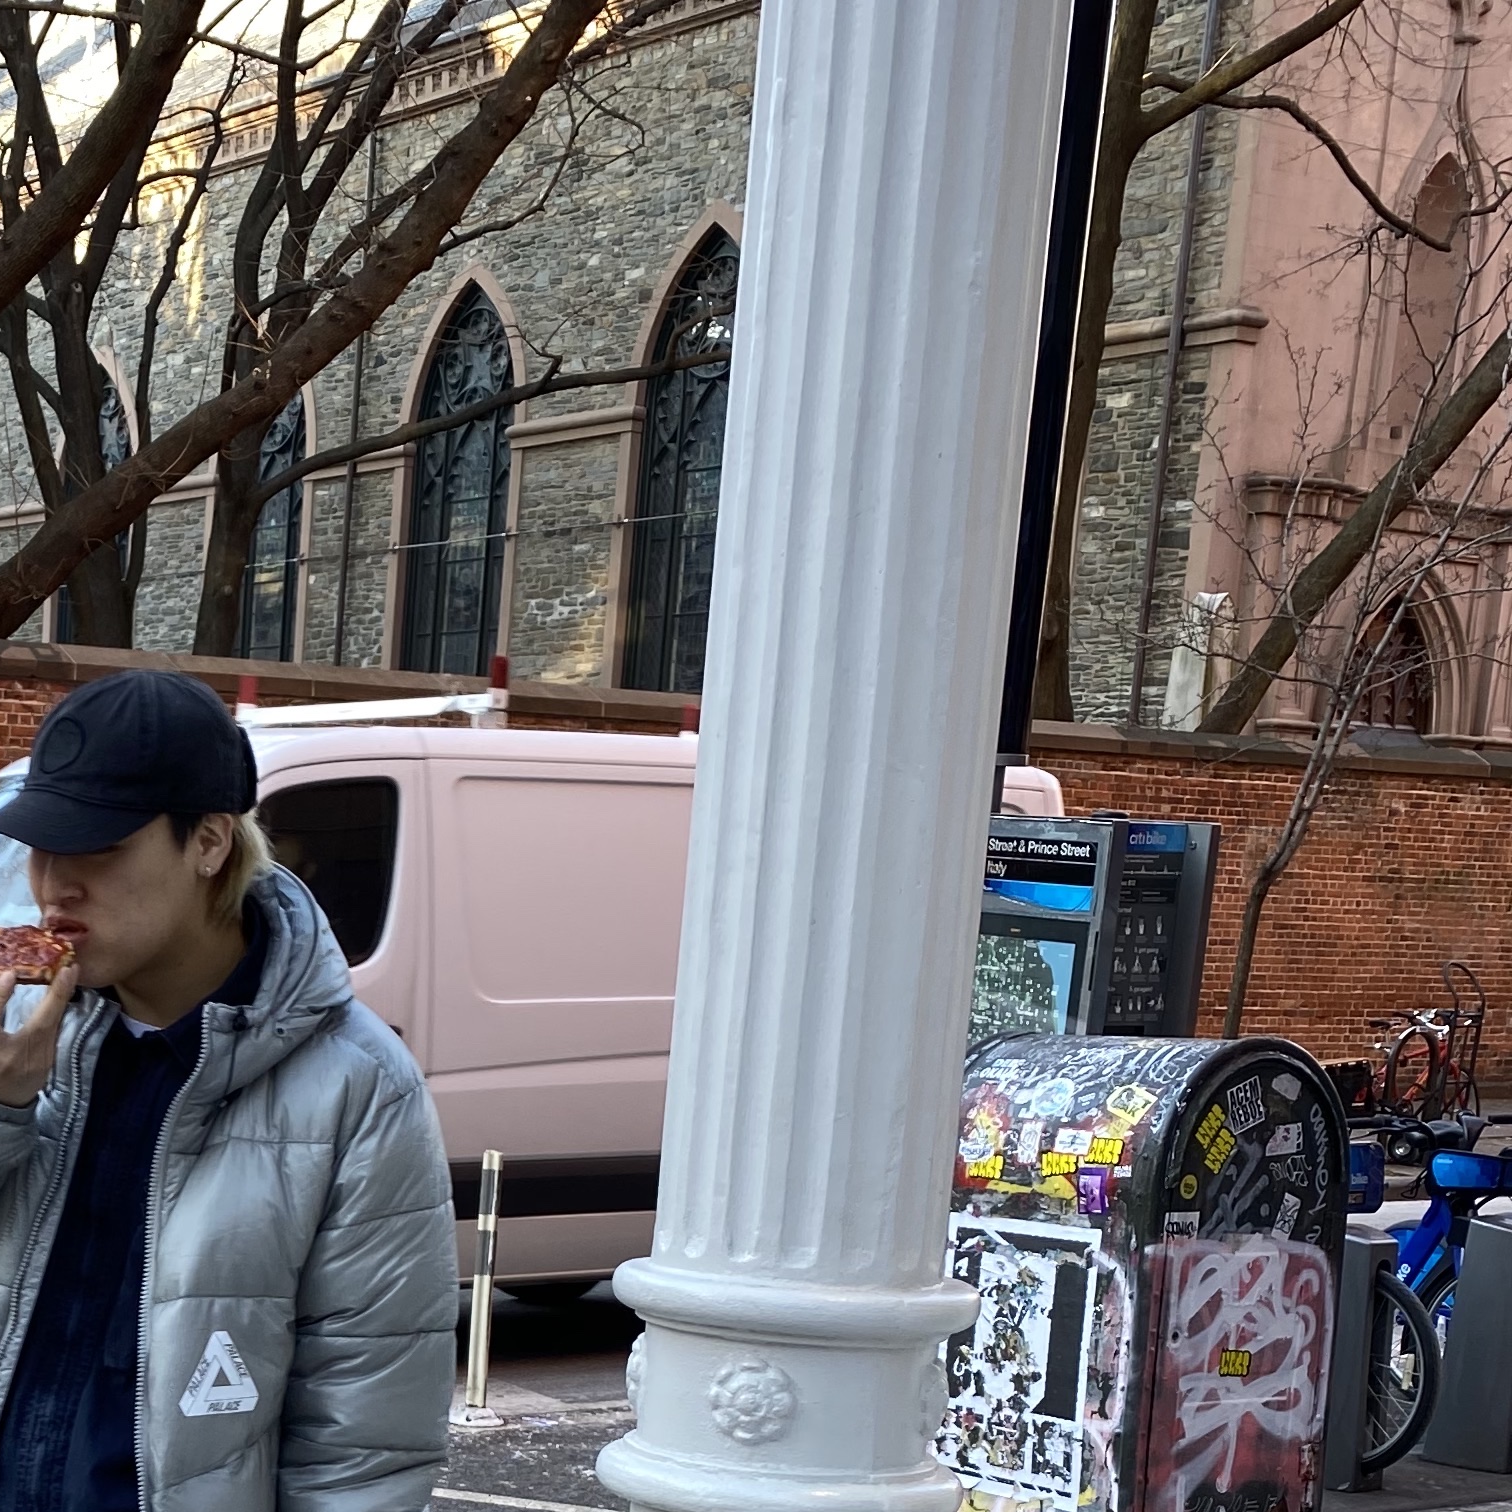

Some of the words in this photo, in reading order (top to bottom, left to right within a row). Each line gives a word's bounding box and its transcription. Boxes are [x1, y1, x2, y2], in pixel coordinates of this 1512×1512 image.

[988, 838, 1017, 852] Street
[1018, 841, 1026, 853] &
[1027, 841, 1059, 856] Prince
[1060, 844, 1091, 858] Street
[224, 1343, 248, 1377] PALACE
[207, 1399, 243, 1412] PALACE
